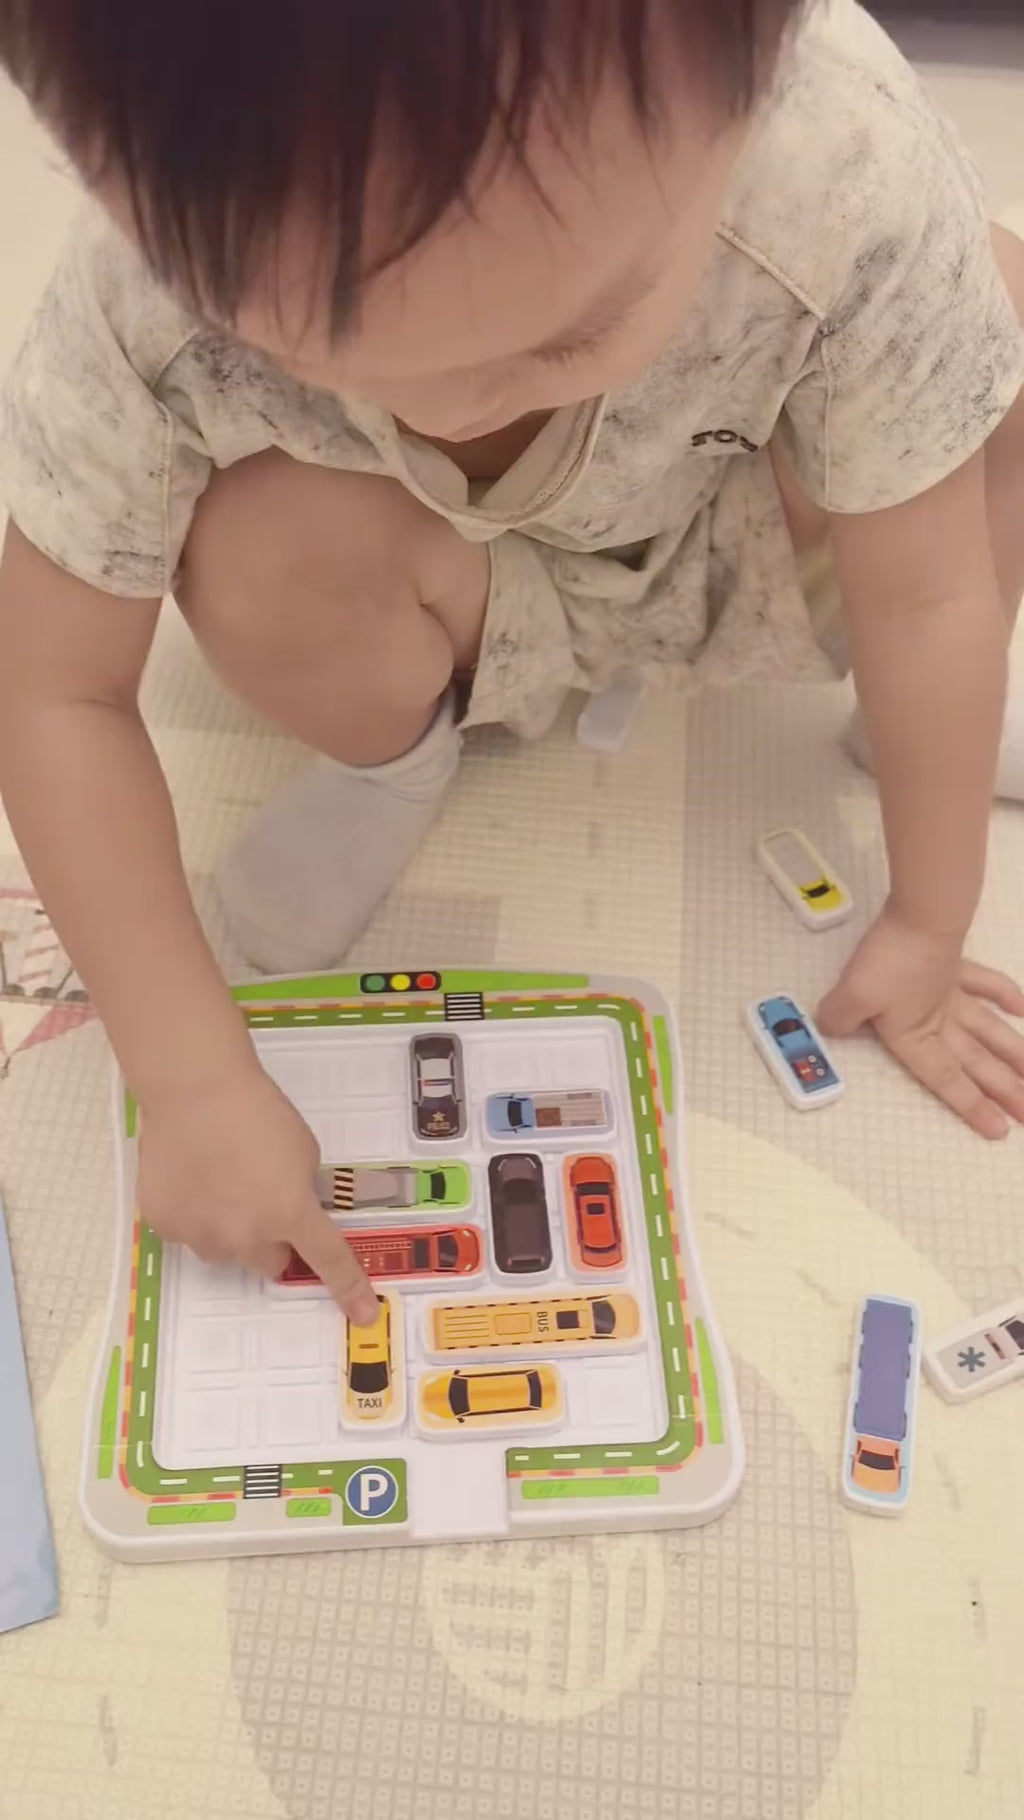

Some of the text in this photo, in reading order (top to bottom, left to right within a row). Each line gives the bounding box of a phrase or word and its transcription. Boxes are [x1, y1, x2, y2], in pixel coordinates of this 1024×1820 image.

[536, 1311, 550, 1333] BUS
[357, 1398, 383, 1409] TAXI
[360, 1473, 388, 1511] P
